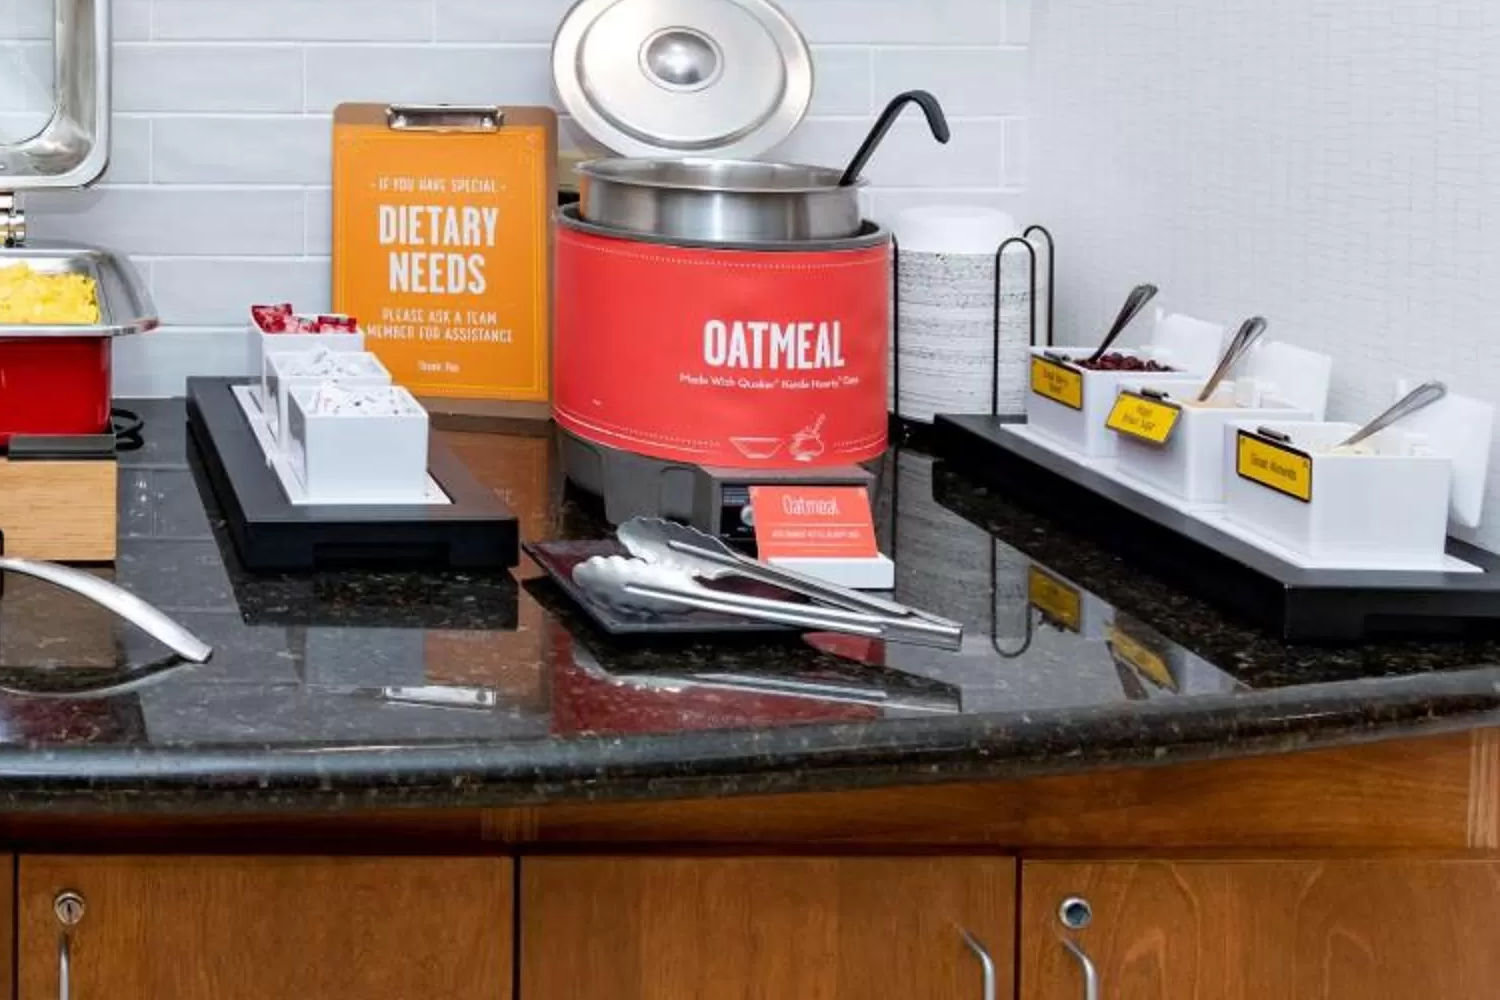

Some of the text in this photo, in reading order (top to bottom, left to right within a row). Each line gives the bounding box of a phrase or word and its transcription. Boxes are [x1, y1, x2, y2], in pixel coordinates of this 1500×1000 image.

[378, 176, 389, 191] IF
[393, 176, 414, 192] YOU
[451, 177, 498, 193] SPECIAL
[378, 204, 499, 247] DIETARY
[388, 251, 486, 295] NEEDS
[381, 308, 498, 325] PLEASE ASK A TEAM
[367, 324, 513, 343] MEMBER FOR ASSISTANCE
[703, 319, 845, 370] OATMEAL
[781, 494, 840, 516] Oatmeal
